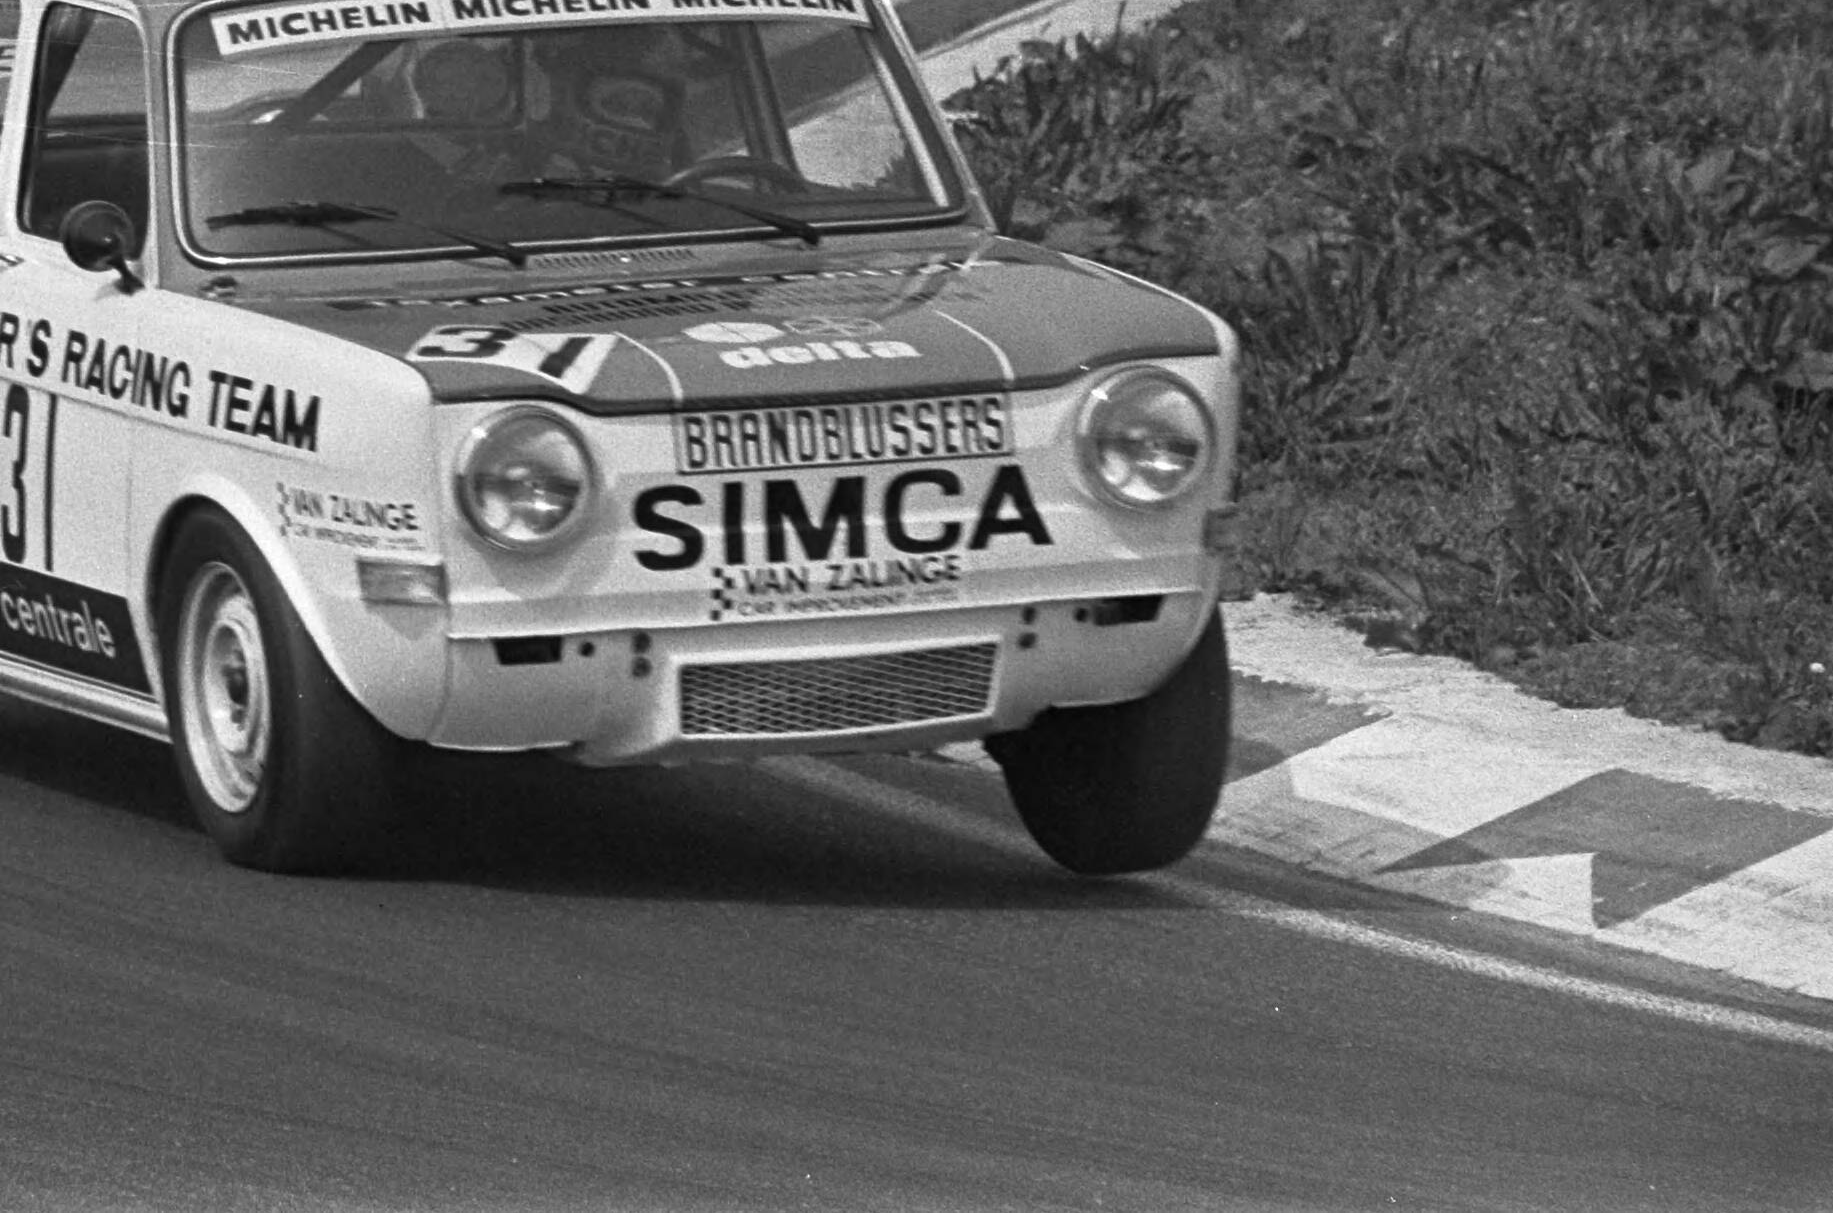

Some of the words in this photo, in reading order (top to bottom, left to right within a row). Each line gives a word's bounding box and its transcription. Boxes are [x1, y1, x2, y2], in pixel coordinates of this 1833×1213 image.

[226, 0, 431, 45] MICHELIN
[416, 325, 596, 380] 31
[60, 328, 191, 420] RACING
[208, 369, 321, 454] TEAM
[683, 396, 1006, 470] BRANDBLUSSERS
[0, 383, 59, 573] 31
[632, 463, 1056, 573] SIMCA
[740, 565, 809, 595] VAN
[825, 553, 962, 592] ZALINGE
[0, 590, 117, 659] centrale
